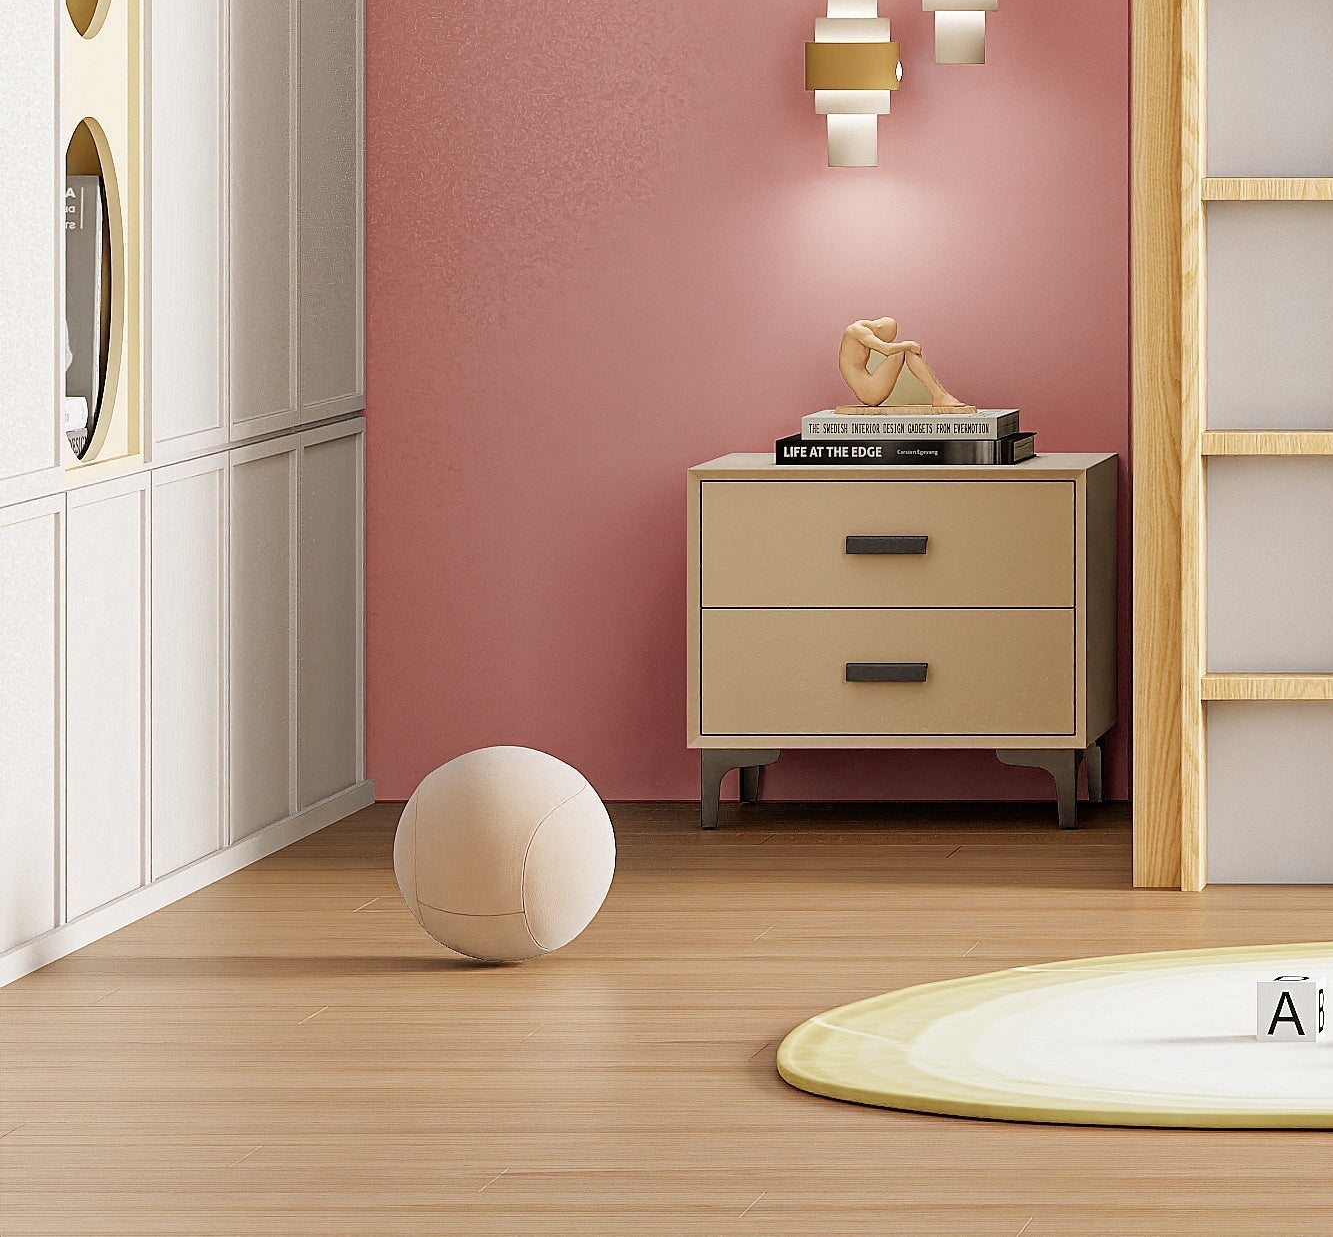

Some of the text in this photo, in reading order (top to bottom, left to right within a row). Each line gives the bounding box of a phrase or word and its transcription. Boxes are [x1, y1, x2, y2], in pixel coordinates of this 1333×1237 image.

[808, 423, 820, 434] THE
[851, 423, 880, 434] INTERIOR
[883, 423, 905, 434] DESIGN
[936, 423, 951, 434] FROM
[783, 446, 882, 458] LIFE AT THE EDGE
[1267, 991, 1306, 1036] A
